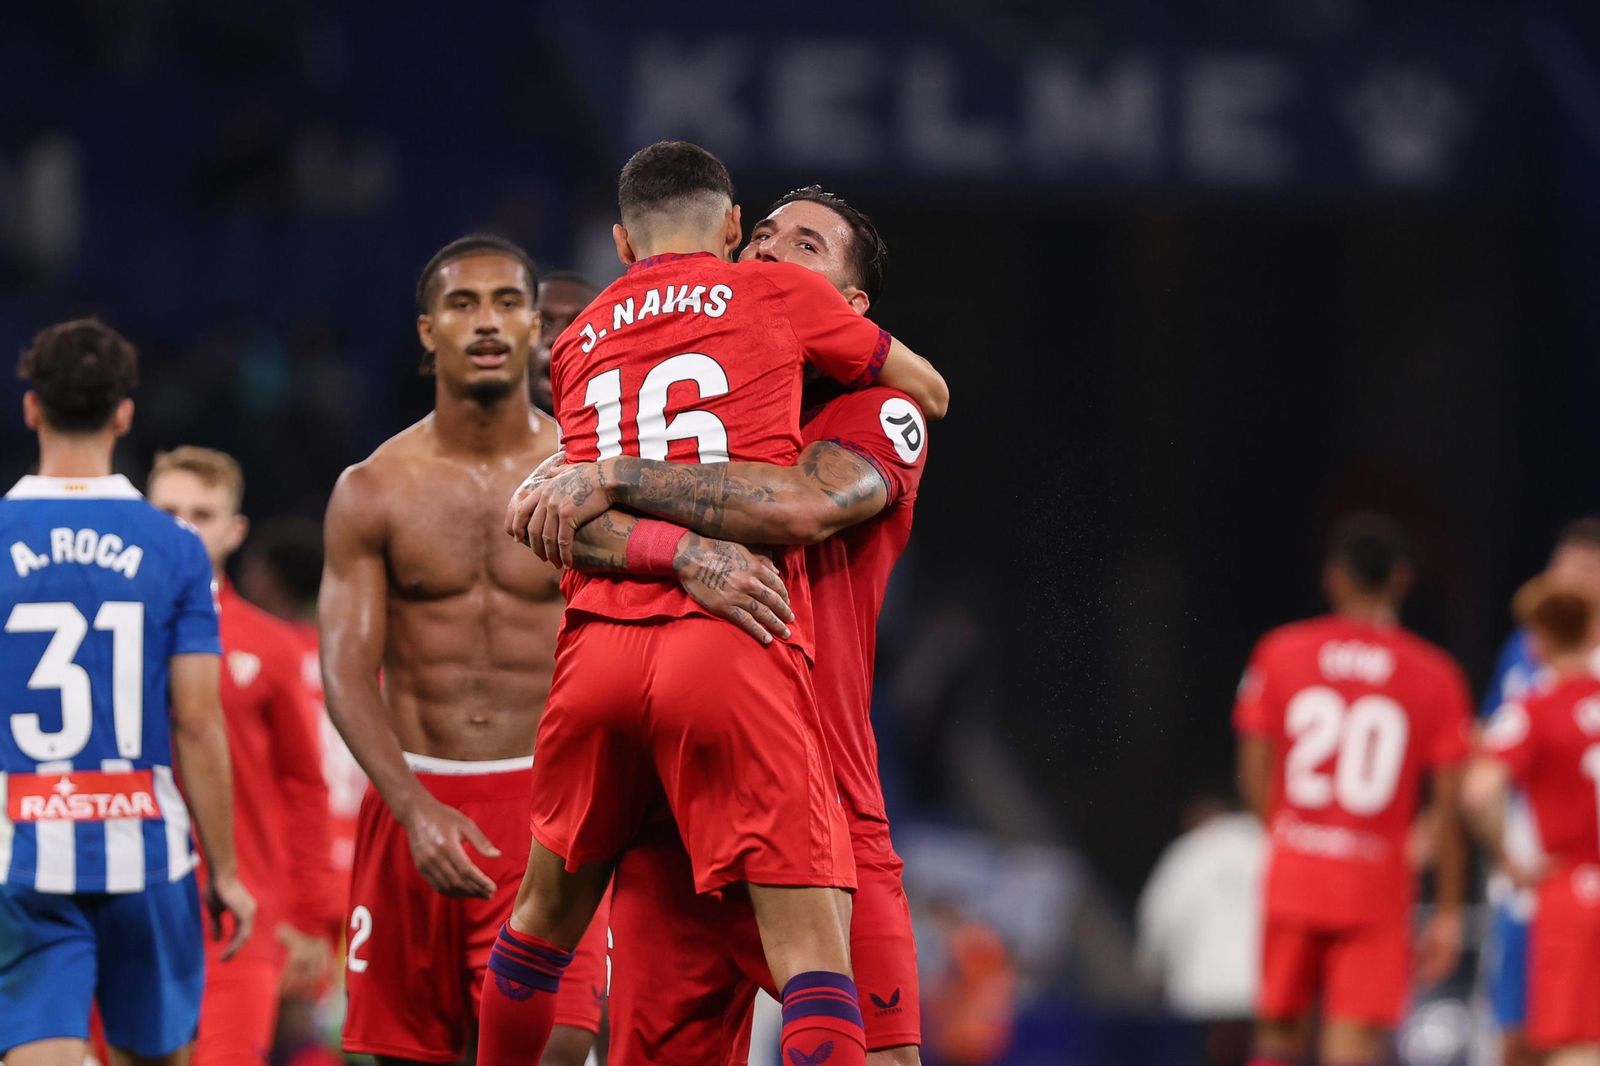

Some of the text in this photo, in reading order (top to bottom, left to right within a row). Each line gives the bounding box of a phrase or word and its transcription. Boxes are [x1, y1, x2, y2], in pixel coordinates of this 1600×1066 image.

[629, 33, 1297, 186] KELME
[579, 283, 733, 353] J. NAVAS
[584, 352, 731, 464] 16
[885, 412, 921, 452] JD
[10, 527, 144, 580] A. ROCA
[5, 601, 144, 761] 31
[1284, 686, 1409, 817] 20
[20, 791, 156, 819] RASTAR
[348, 904, 373, 974] 2
